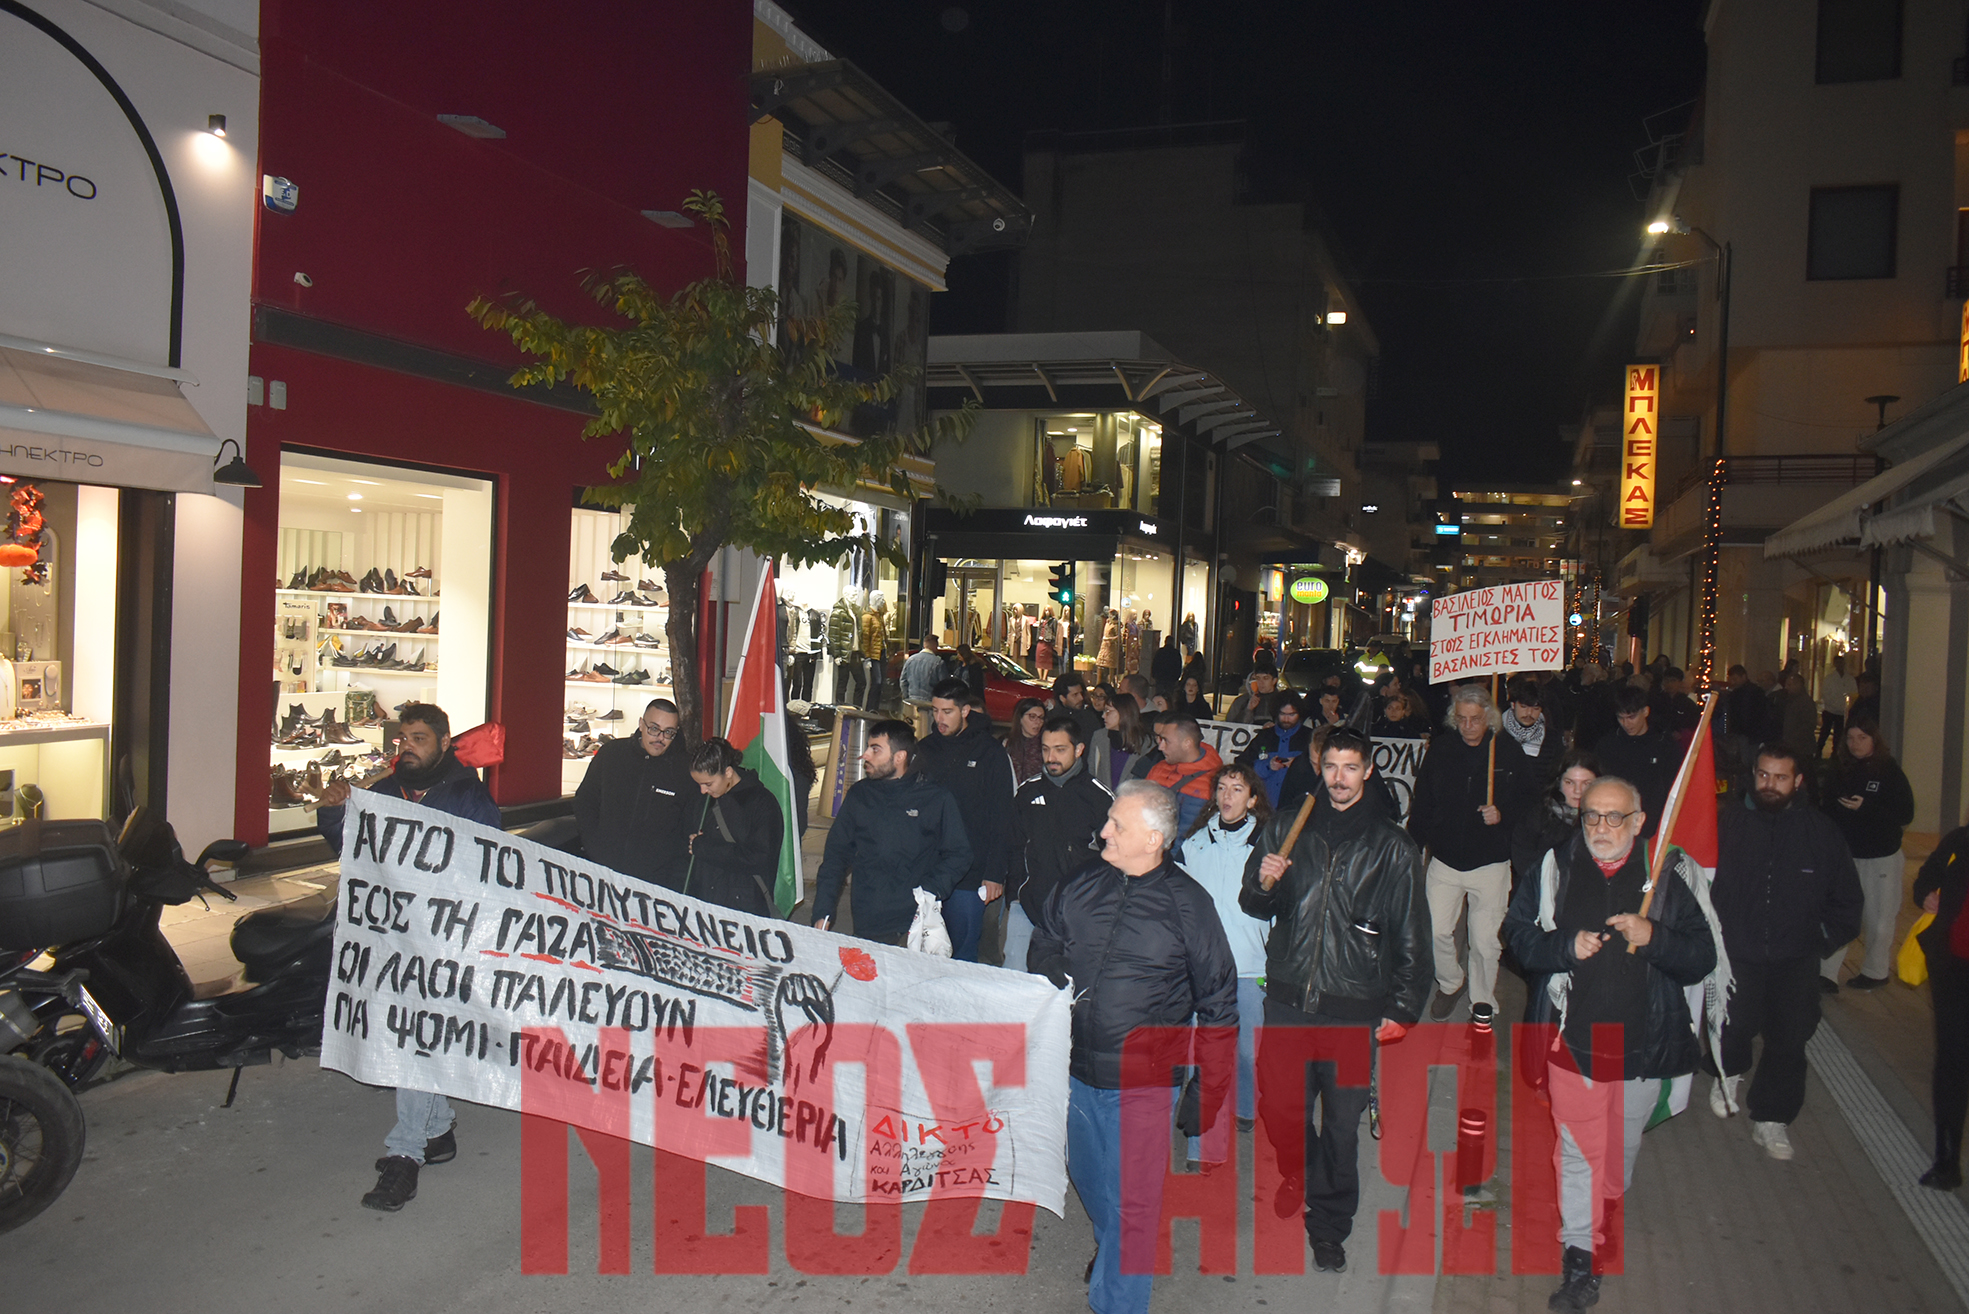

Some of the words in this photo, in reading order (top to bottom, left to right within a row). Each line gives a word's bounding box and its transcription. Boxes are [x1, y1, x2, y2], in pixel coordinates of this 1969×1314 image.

[1624, 368, 1656, 525] ΜΠΛΕΚΑΣ
[1023, 514, 1088, 529] Λαφαγιέτ
[1296, 581, 1322, 592] euro
[1433, 588, 1495, 619] ΒΑΣΙΛΕΙΟΣ
[1501, 580, 1562, 604] ΜΑΓΓΟΣ
[1448, 603, 1536, 632] ΤΙΜΩΡΙΑ
[1430, 635, 1465, 658] ΣΤΟΥΣ
[1469, 625, 1560, 650] ΕΓΚΛΗΜΑΤΙΕΣ
[1433, 648, 1519, 678] ΒΑΣΑΝΙΣΤΕΣ
[1528, 647, 1560, 663] ΤΟΥ
[353, 809, 455, 874] ΑΠΟ
[474, 836, 525, 890] ΤΟ
[538, 858, 795, 965] ΠΟΛΥΤΕΧΝΕΙΟ
[347, 878, 417, 934] ΕΩΣ
[427, 898, 480, 952] ΤΗ
[496, 907, 596, 964] ΓΑΖΑ
[337, 941, 371, 988] ΟΙ
[375, 951, 475, 1005] ΛΑΟΙ
[491, 970, 696, 1047] ΠΑΛΕΥΟΥΝ
[872, 1114, 1004, 1146] ΔΙΚΤΟ
[870, 1165, 889, 1175] και
[871, 1168, 1001, 1194] ΚΑΡΔΙΤΣΑΣ
